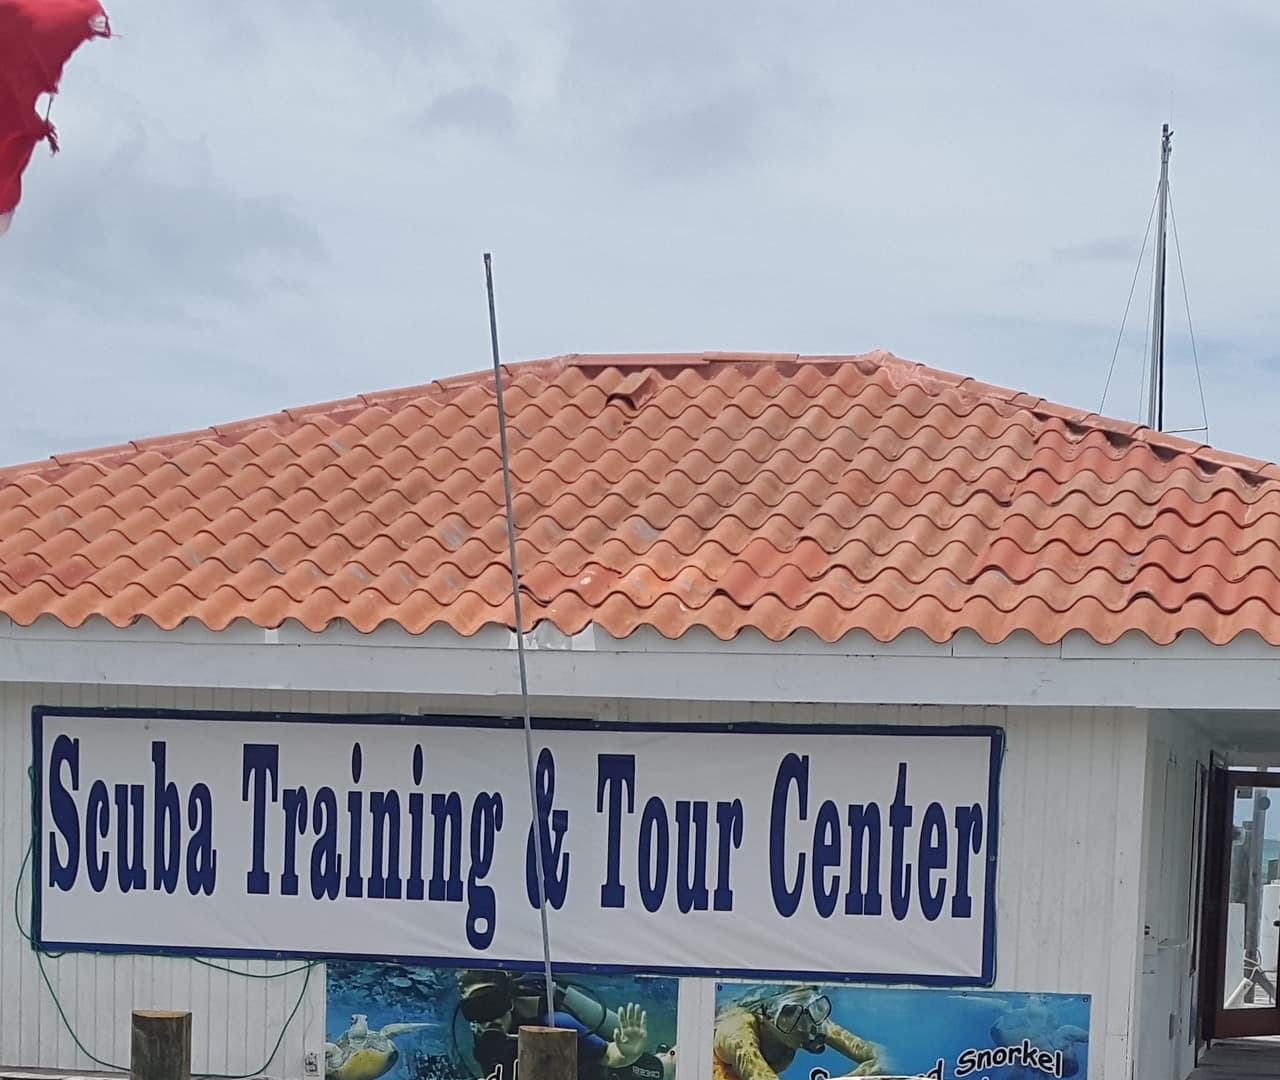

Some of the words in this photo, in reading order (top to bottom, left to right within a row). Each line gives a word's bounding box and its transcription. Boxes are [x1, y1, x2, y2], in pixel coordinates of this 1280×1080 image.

[49, 734, 217, 895] Scuba
[242, 742, 503, 950] Training
[525, 748, 570, 910] &
[597, 753, 743, 914] Tour
[769, 752, 983, 921] Center
[955, 1039, 1064, 1079] Snorkel
